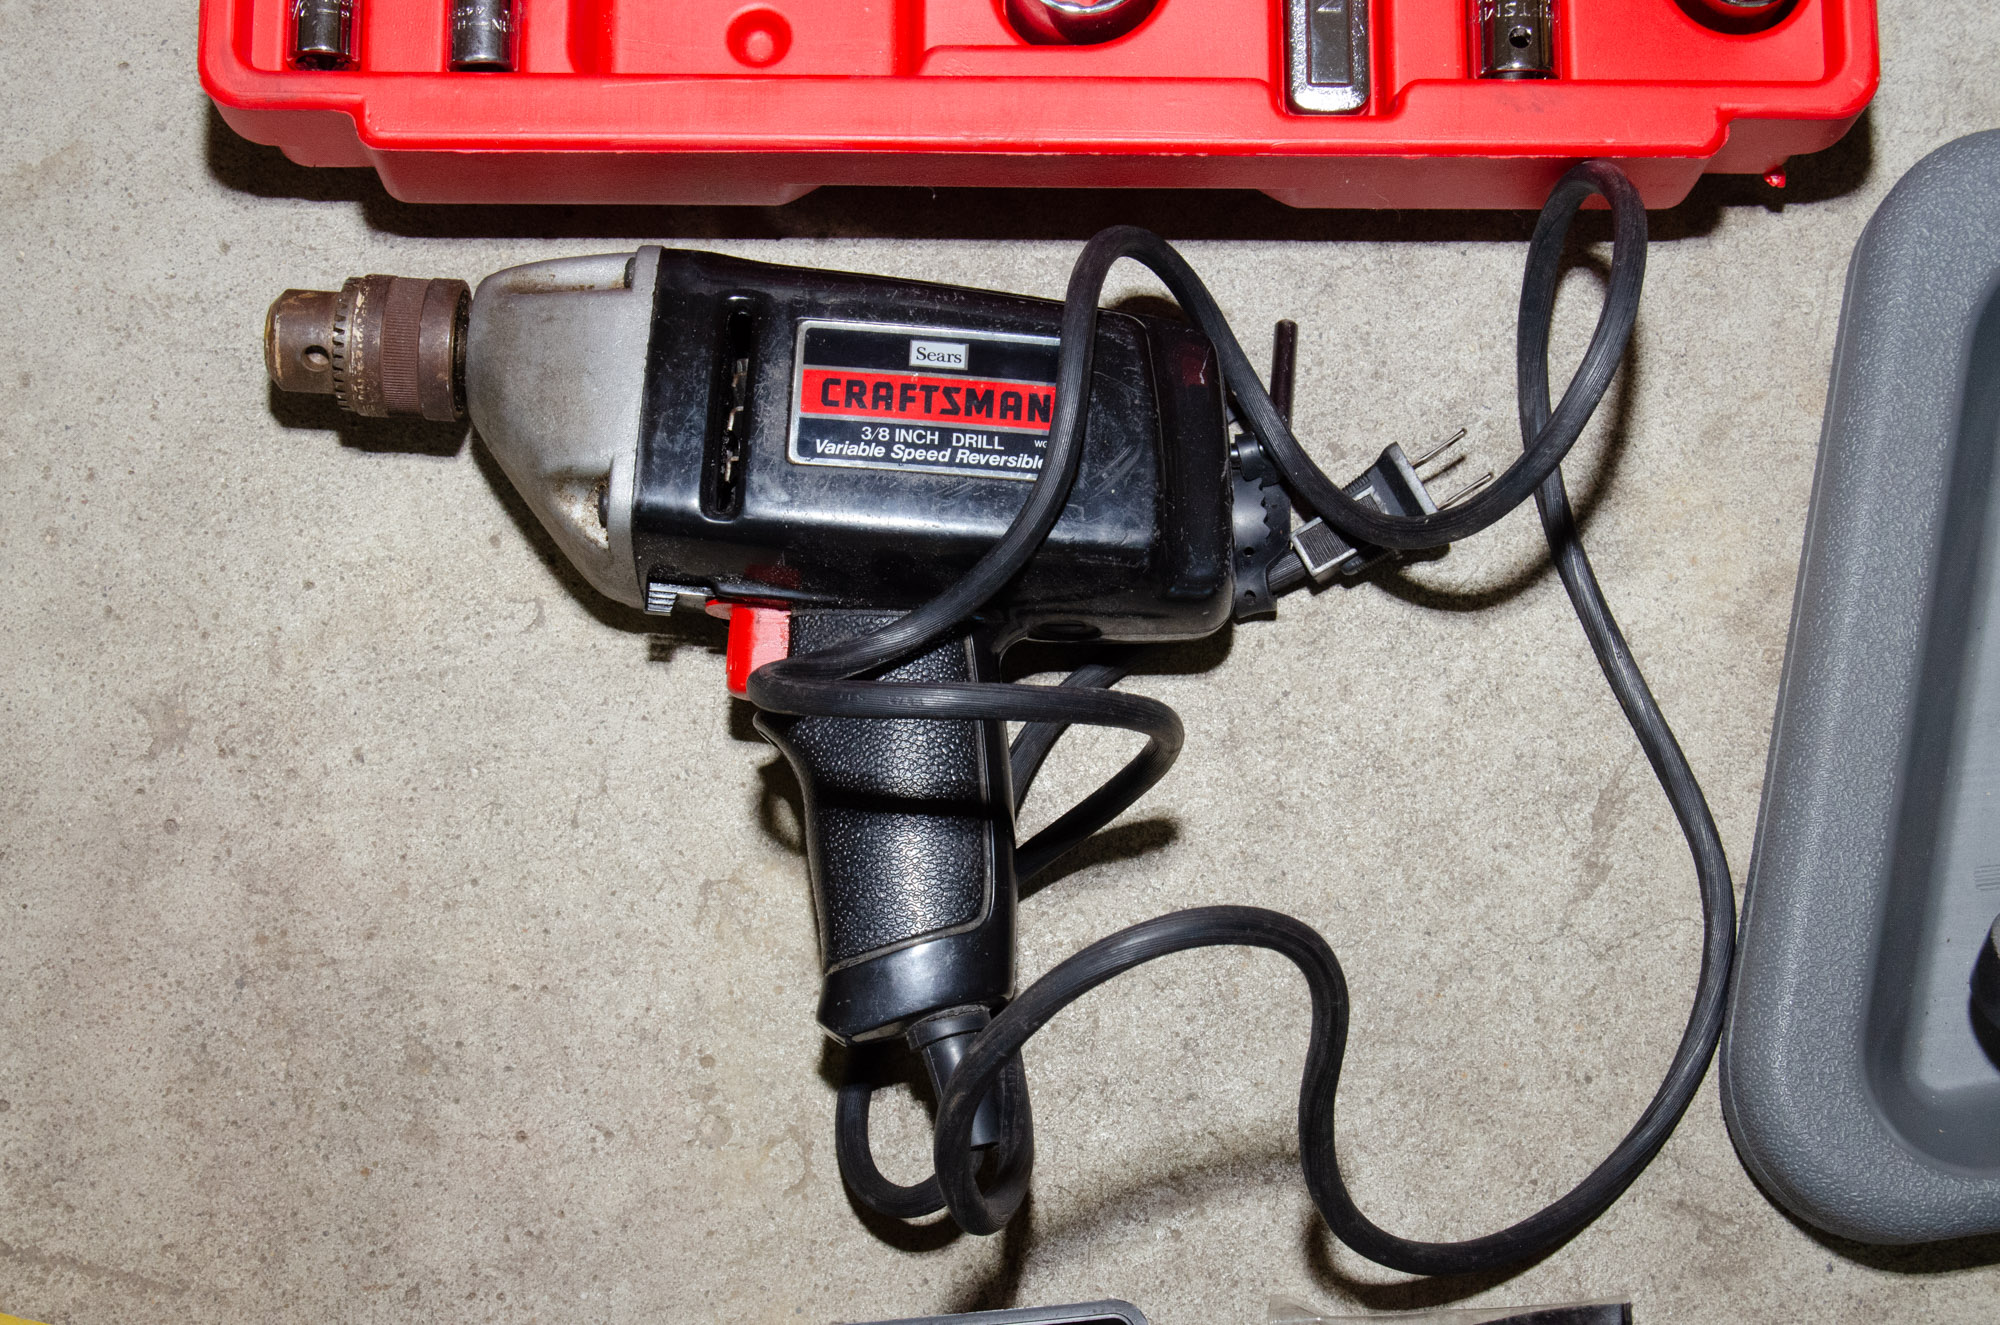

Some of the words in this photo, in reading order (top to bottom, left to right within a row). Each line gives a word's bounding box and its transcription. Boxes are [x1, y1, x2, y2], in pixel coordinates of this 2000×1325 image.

[916, 346, 963, 365] Sears
[821, 378, 1051, 423] CRAFTSMAN
[861, 426, 890, 442] 3/8
[895, 428, 939, 445] INCH
[952, 433, 1005, 450] DRILL
[815, 438, 885, 458] Variable
[890, 445, 951, 463] Speed
